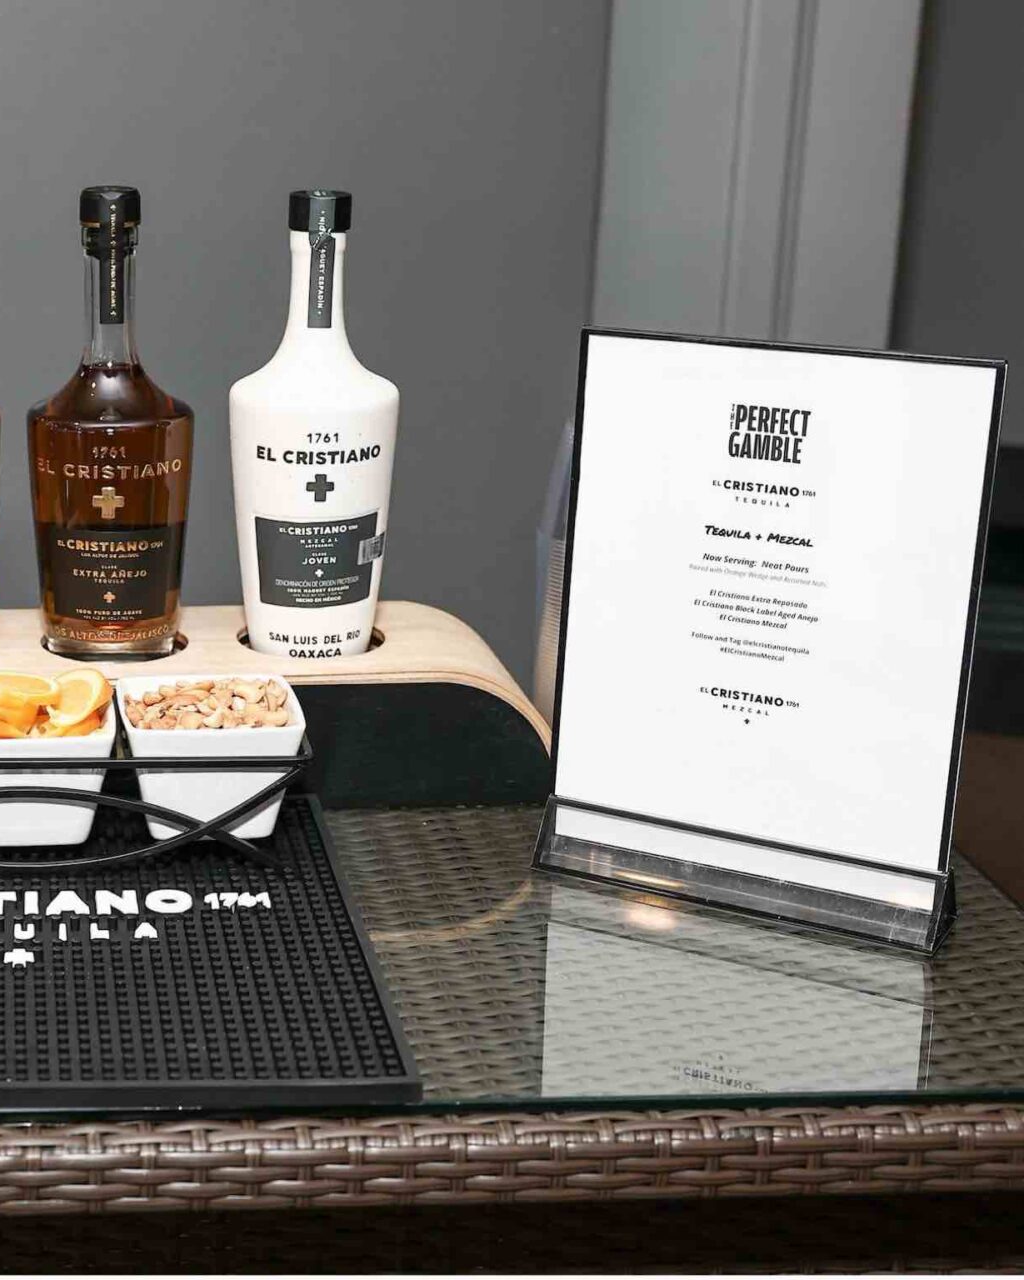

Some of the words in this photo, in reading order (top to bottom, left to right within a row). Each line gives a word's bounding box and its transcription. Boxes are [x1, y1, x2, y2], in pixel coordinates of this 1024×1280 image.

[735, 404, 811, 437] PERFECT
[307, 433, 339, 443] 1761
[92, 447, 126, 458] 1761
[257, 445, 276, 462] EL
[283, 445, 381, 464] CRISTIANO
[728, 431, 803, 464] GAMBLE
[37, 458, 55, 474] EL
[63, 459, 181, 480] CRISTIANO
[723, 480, 799, 497] CRISTIANO
[736, 496, 790, 508] TEQUILA
[288, 525, 347, 535] CRISTIANO
[705, 525, 751, 540] TEQUILA
[767, 533, 814, 547] MEZCAL
[67, 539, 148, 551] CRISTIANO
[302, 557, 337, 565] JOVEN
[703, 553, 722, 562] Now
[724, 555, 757, 568] Serving:
[762, 560, 782, 570] Neat
[785, 564, 809, 574] Pours
[73, 569, 105, 578] EXTRA
[111, 570, 147, 578] AÑEJO
[718, 590, 750, 601] Cristiano
[751, 595, 771, 604] Extra
[702, 600, 734, 611] Cristiano
[736, 604, 755, 613] Black
[757, 607, 777, 616] Label
[778, 610, 796, 620] Aged
[728, 615, 760, 626] Cristiano
[762, 620, 787, 630] Mezcal
[269, 631, 290, 643] SAN
[294, 634, 317, 645] LUIS
[324, 633, 342, 644] DEL
[692, 632, 713, 641] Follow
[289, 648, 342, 658] OAXACA
[711, 687, 784, 706] CRISTIANO
[723, 704, 770, 716] MEZCAL
[204, 891, 272, 913] 1761
